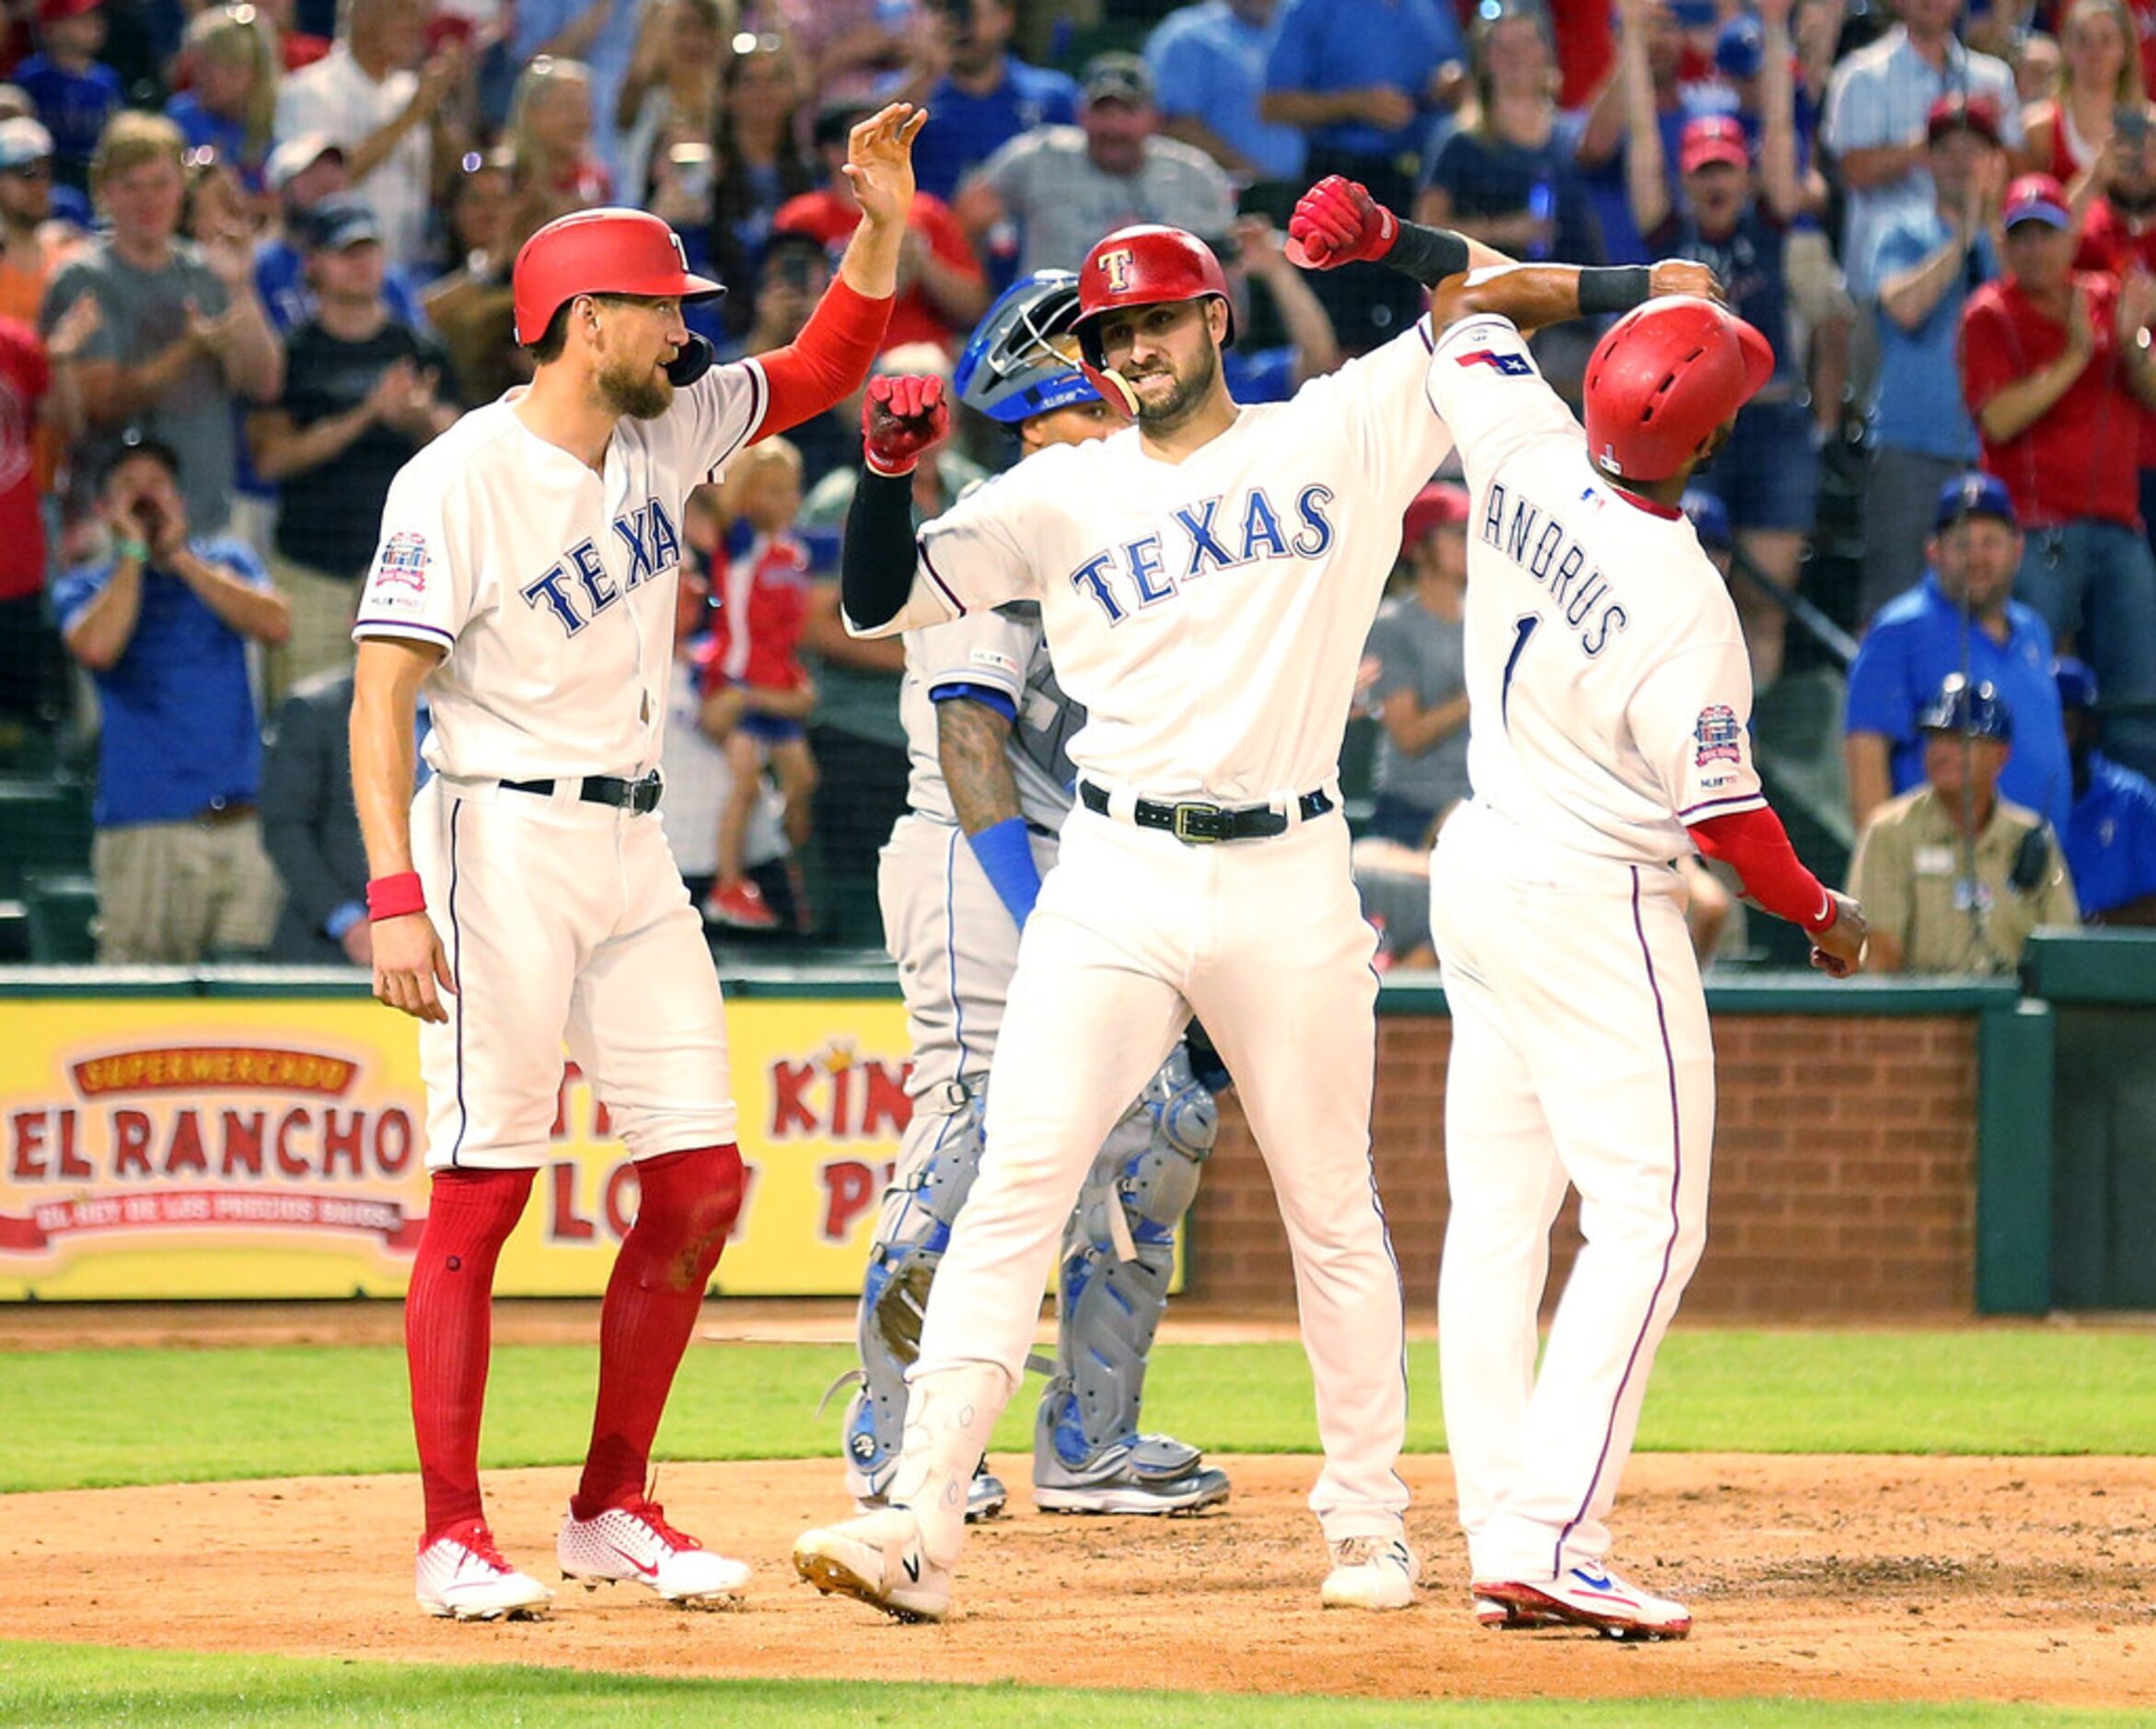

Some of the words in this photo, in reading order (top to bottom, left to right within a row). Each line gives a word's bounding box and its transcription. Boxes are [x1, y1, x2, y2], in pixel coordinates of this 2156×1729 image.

[1097, 249, 1133, 292] T
[519, 495, 681, 638] TEXA
[1069, 483, 1335, 628] TEXAS
[1482, 483, 1629, 657] ANDRUS
[1501, 611, 1543, 733] 1
[14, 1109, 92, 1177] EL
[115, 1108, 412, 1177] RANCHO
[773, 1060, 913, 1136] KIN
